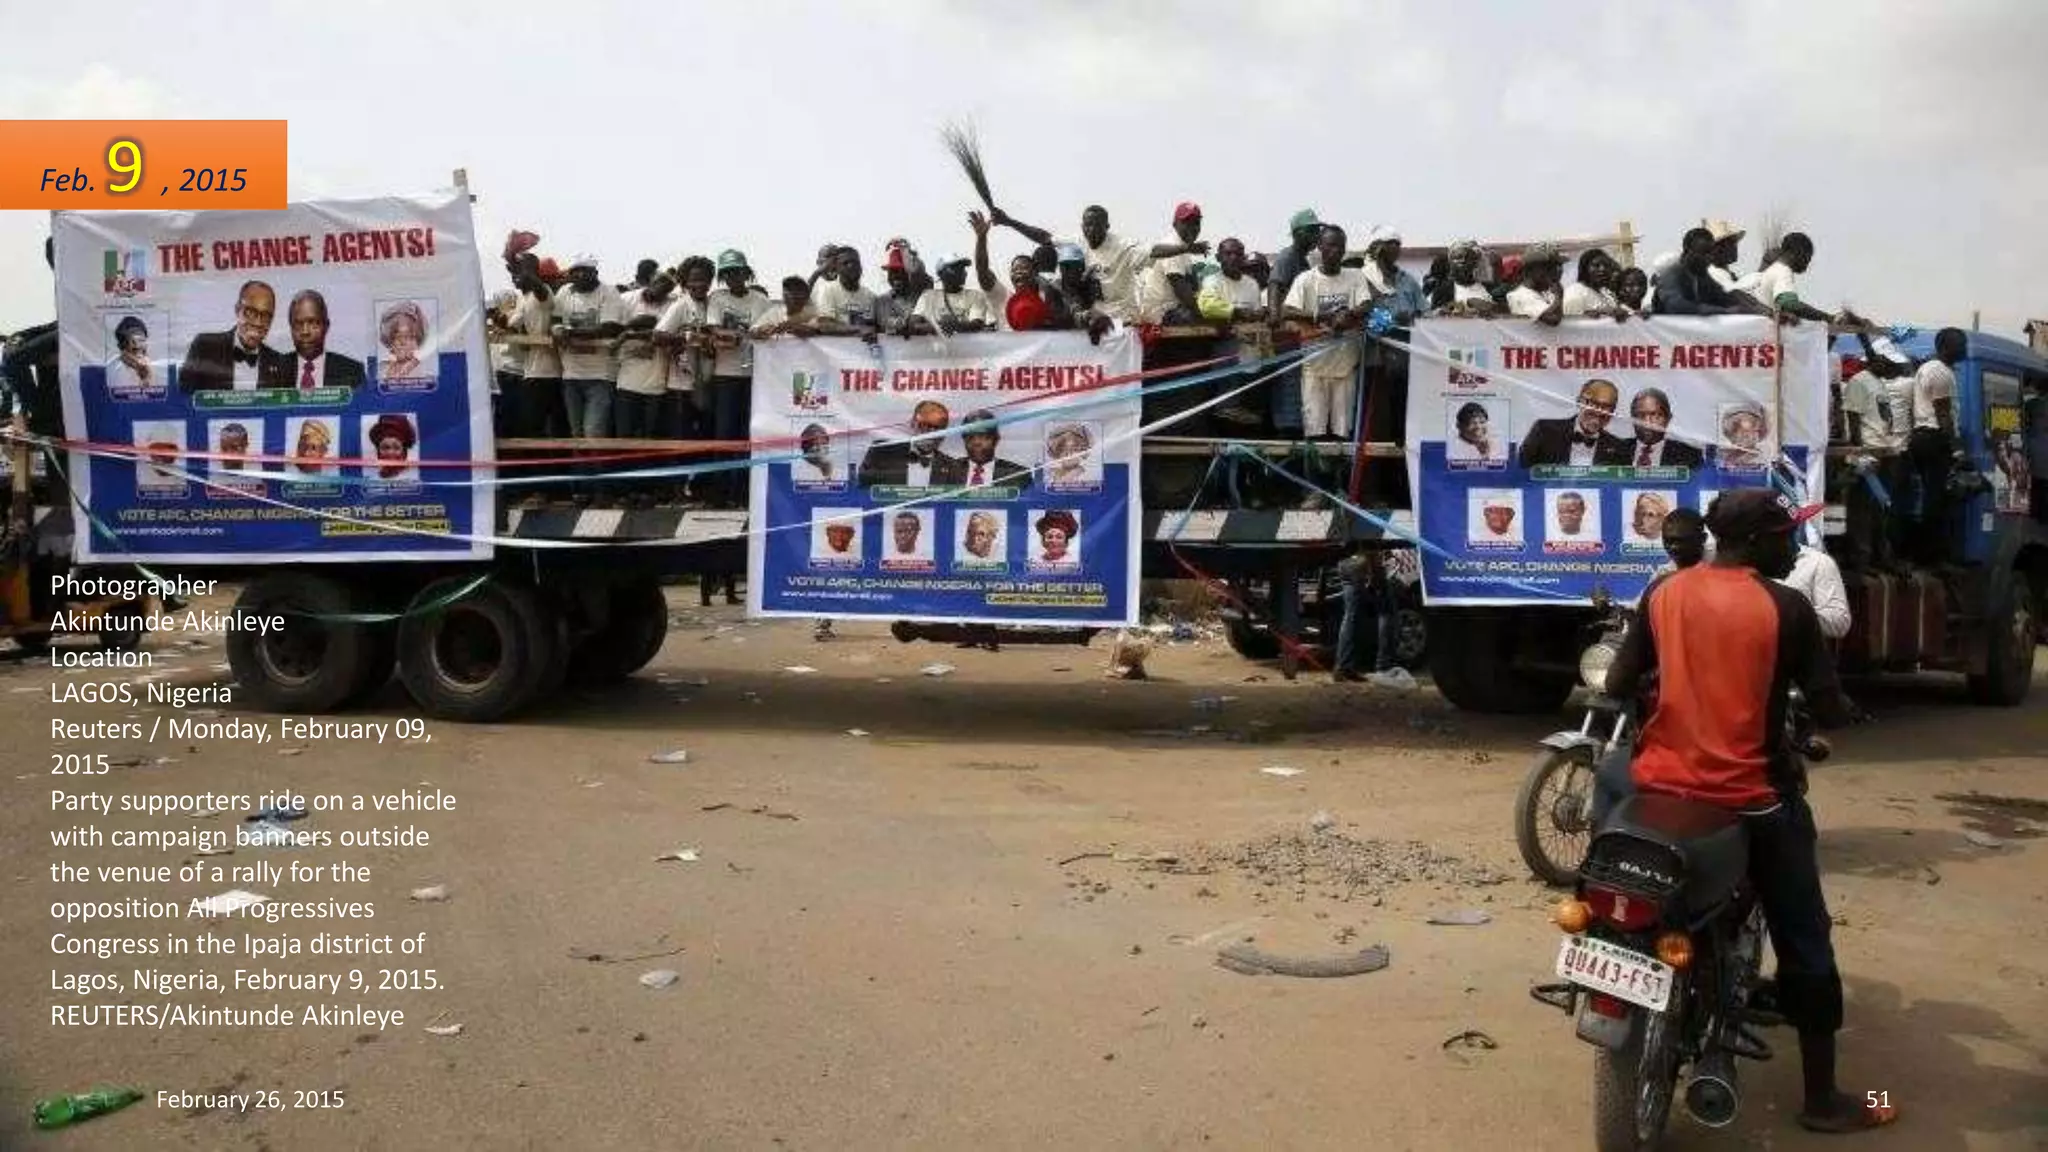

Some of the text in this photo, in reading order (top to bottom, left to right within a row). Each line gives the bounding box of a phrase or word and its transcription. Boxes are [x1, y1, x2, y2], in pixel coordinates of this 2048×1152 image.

[157, 227, 436, 273] THE CHANGE AGENTS!
[1501, 346, 1547, 369] THE
[1557, 345, 1660, 369] CHANGE
[841, 365, 1104, 391] THE CHANGE AGENTS!
[119, 508, 156, 521] VOTE
[385, 505, 446, 518] BETTER
[1526, 562, 1591, 573] CHANGE
[1595, 563, 1656, 574] NIGERIA
[788, 576, 825, 587] VOTE
[986, 582, 1014, 593] FOR
[1018, 582, 1045, 593] THE
[1047, 582, 1103, 594] BETTER
